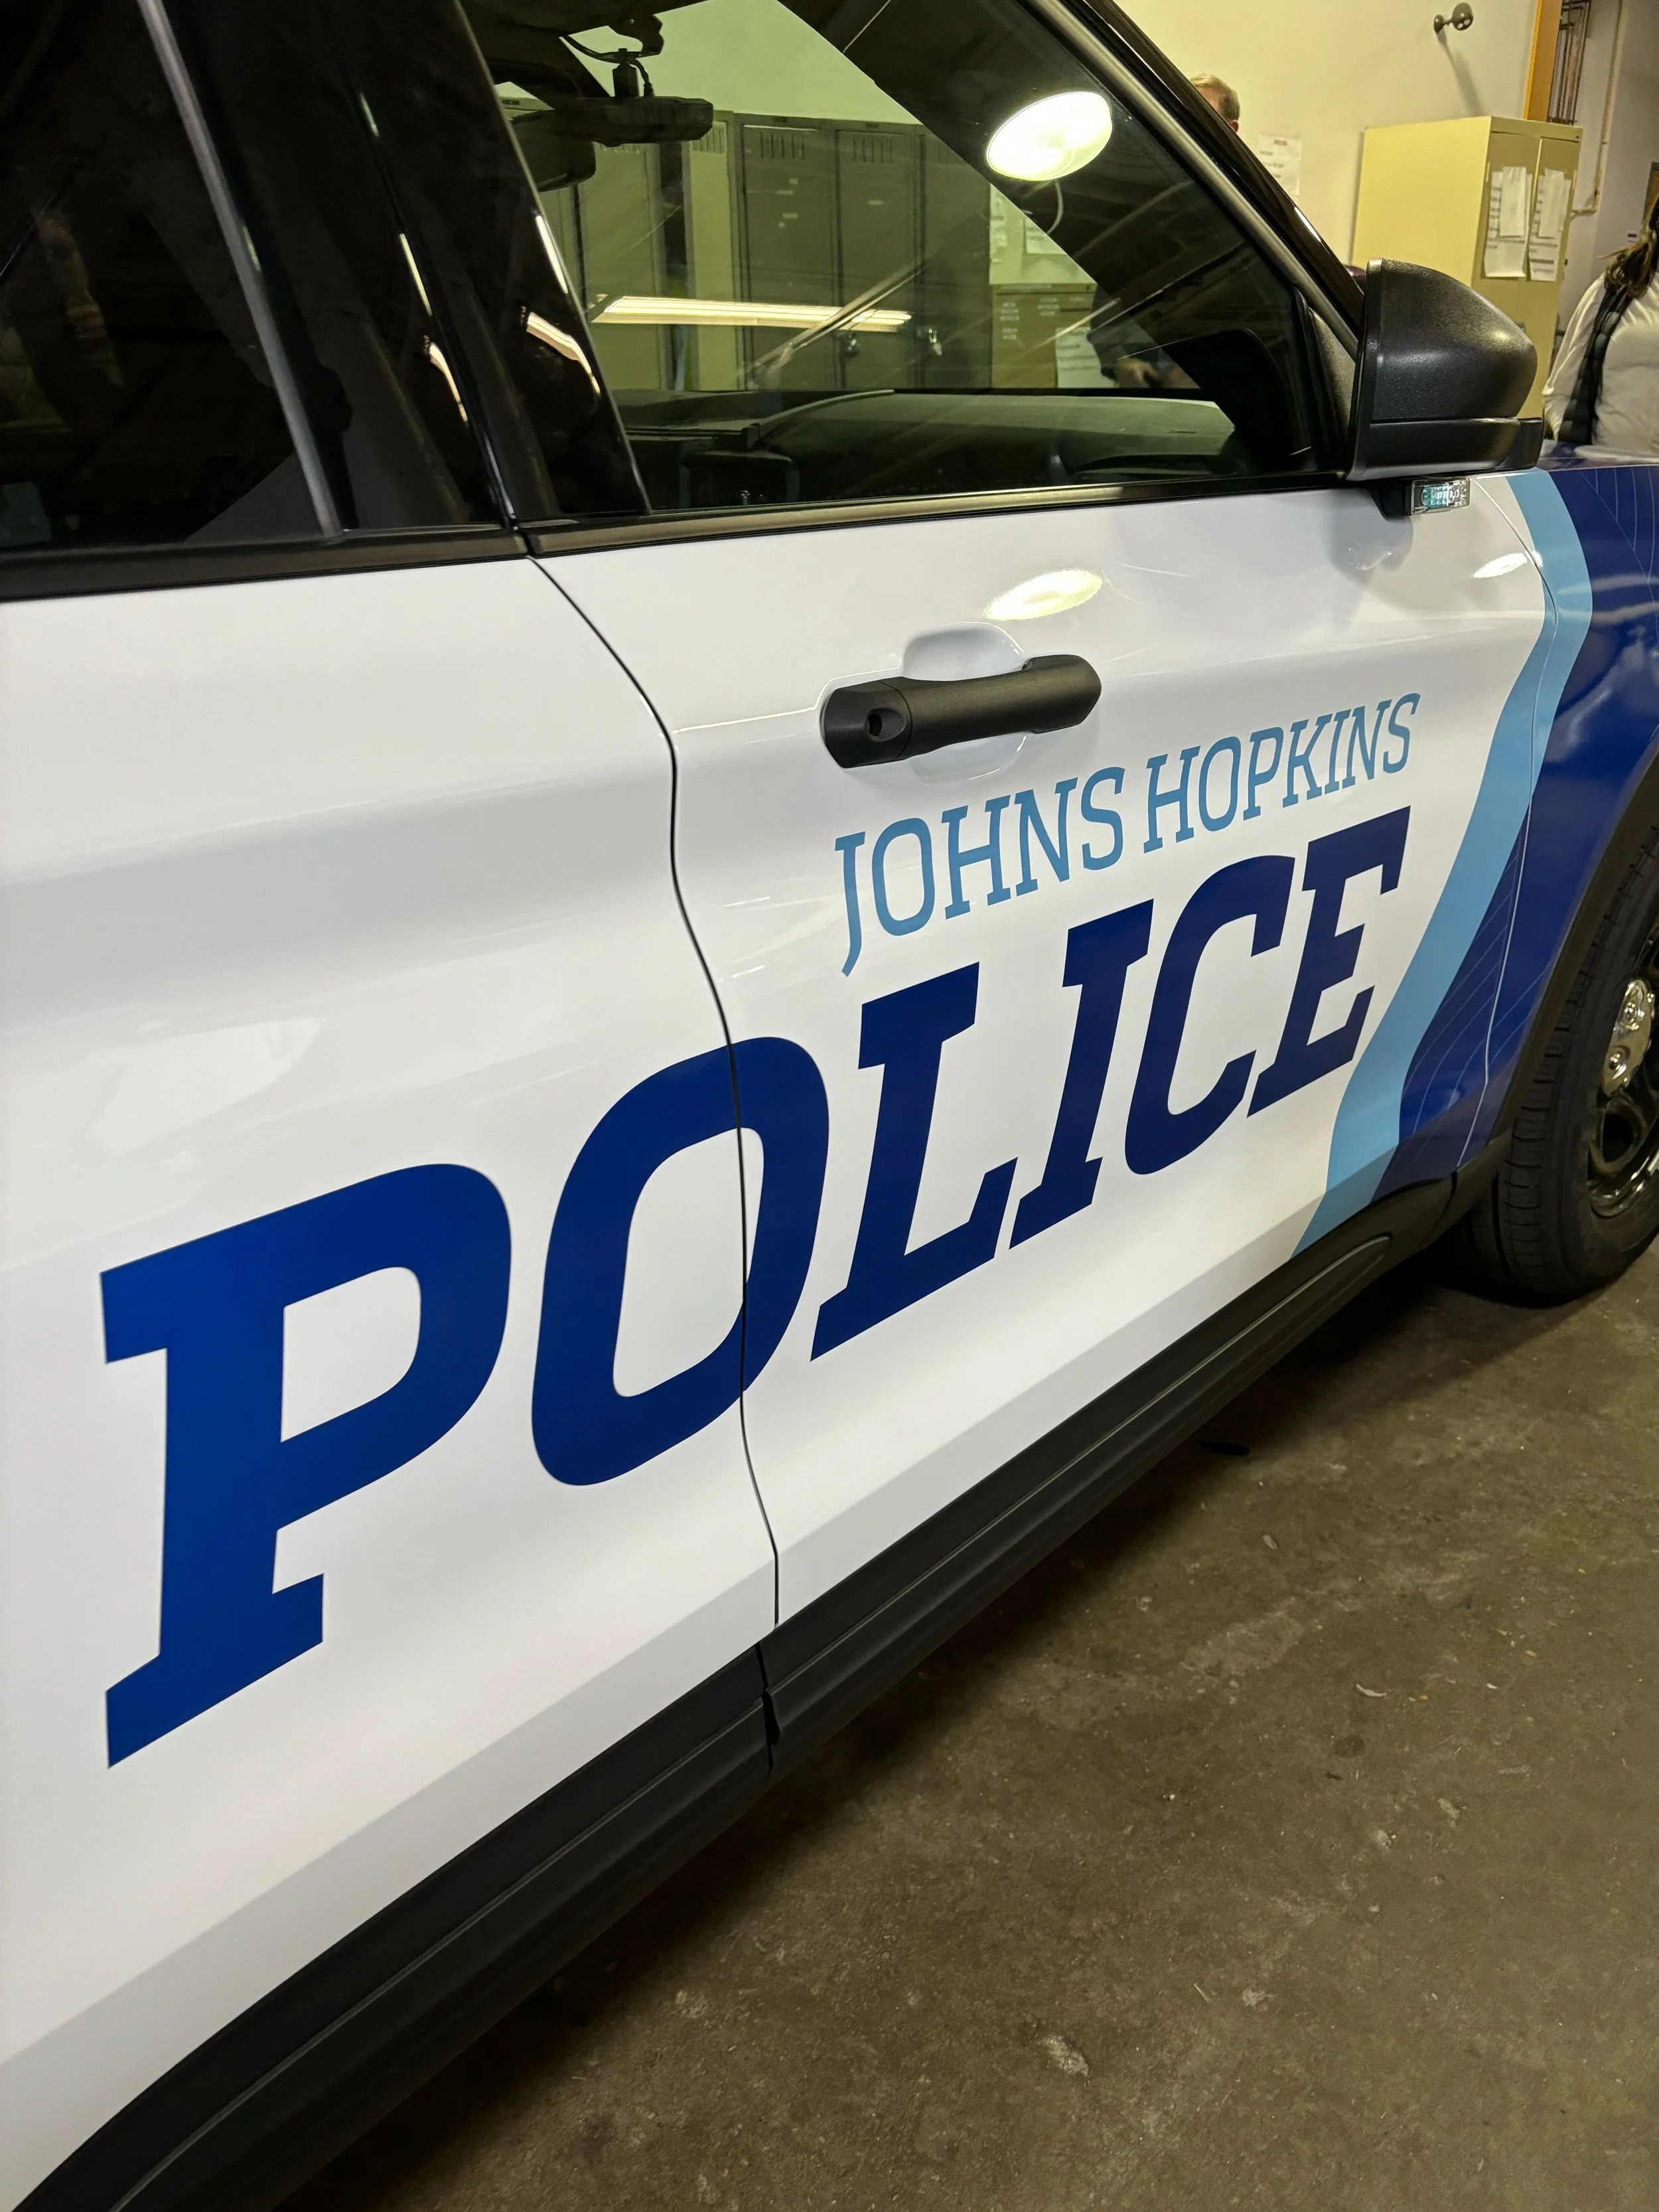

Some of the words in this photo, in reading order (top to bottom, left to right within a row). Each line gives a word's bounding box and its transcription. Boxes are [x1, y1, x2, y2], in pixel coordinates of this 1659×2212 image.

[835, 767, 1124, 976] JOHNS
[1143, 693, 1421, 854] HOPKINS
[101, 807, 1409, 1767] POLICE
